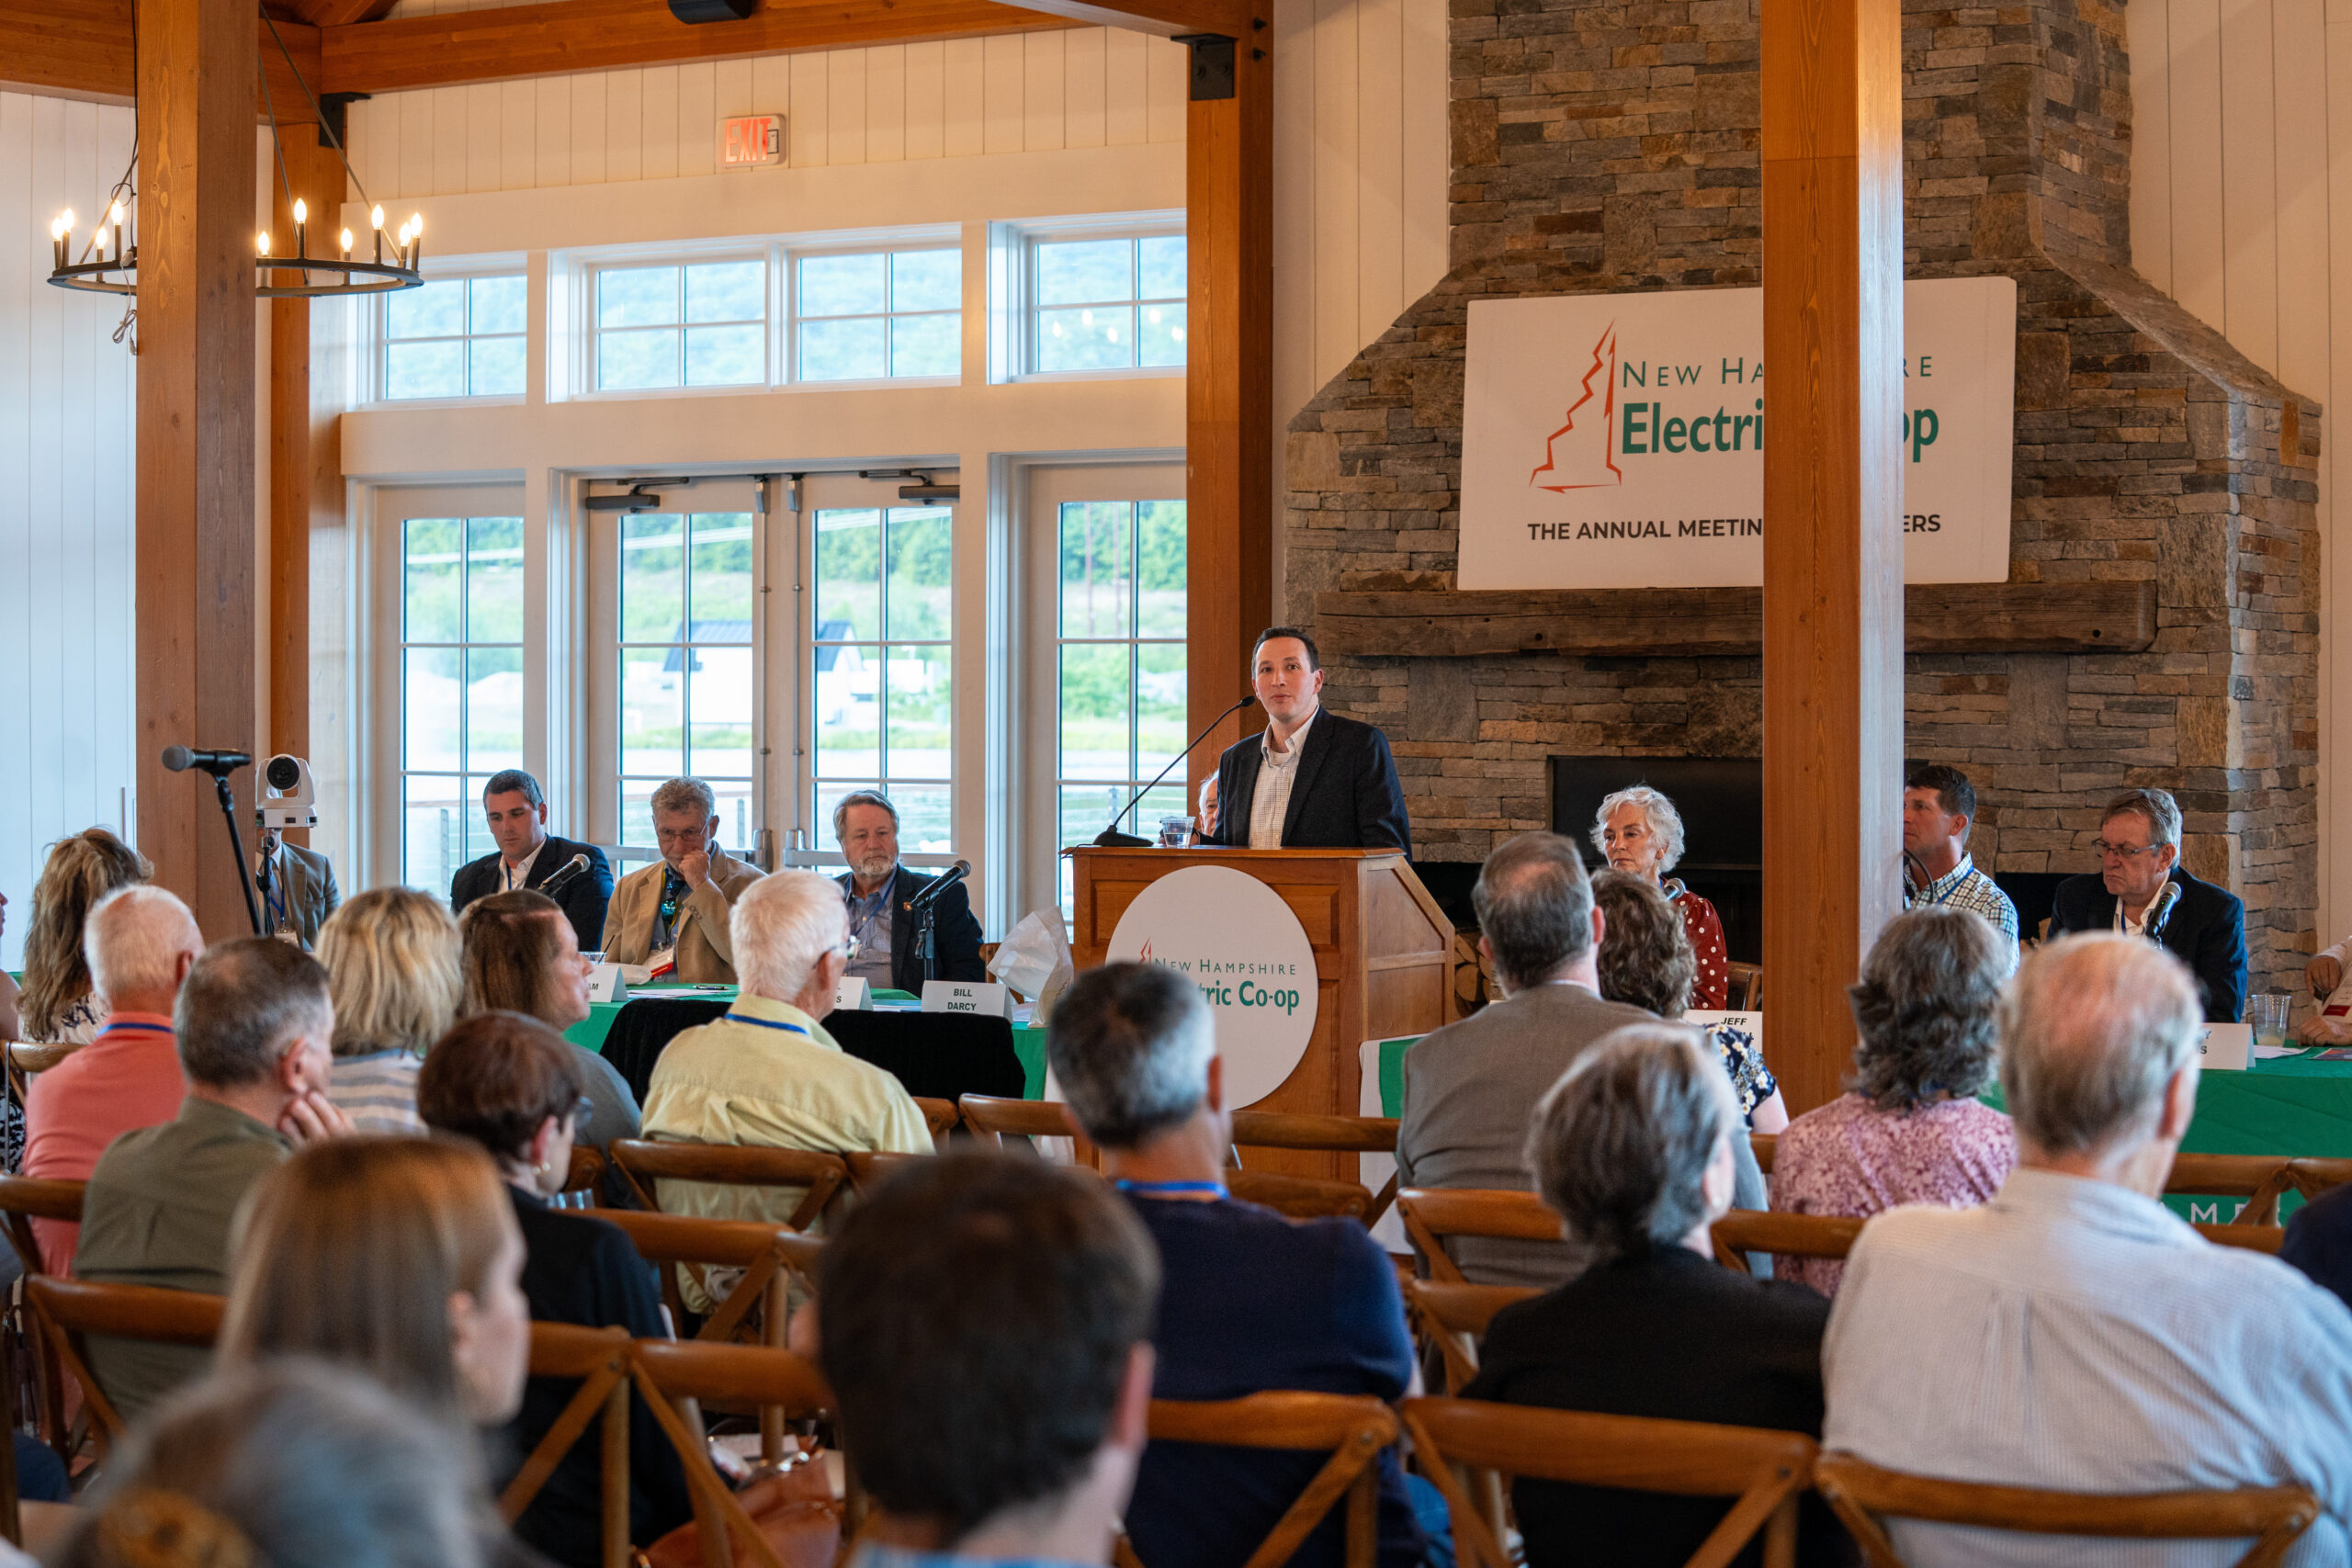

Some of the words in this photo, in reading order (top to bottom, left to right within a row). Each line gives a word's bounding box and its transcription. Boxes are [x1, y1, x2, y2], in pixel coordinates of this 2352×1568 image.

[725, 118, 773, 163] EXIT
[1622, 397, 1763, 455] Electri
[1527, 522, 1571, 541] THE
[1576, 520, 1672, 540] ANNUAL
[1678, 518, 1763, 538] MEETIN
[1199, 959, 1296, 976] HAMPSHIRE
[953, 987, 973, 998] BILL
[1238, 980, 1299, 1016] Co-op
[947, 1001, 977, 1011] DARCY
[1720, 1017, 1747, 1026] JEFF
